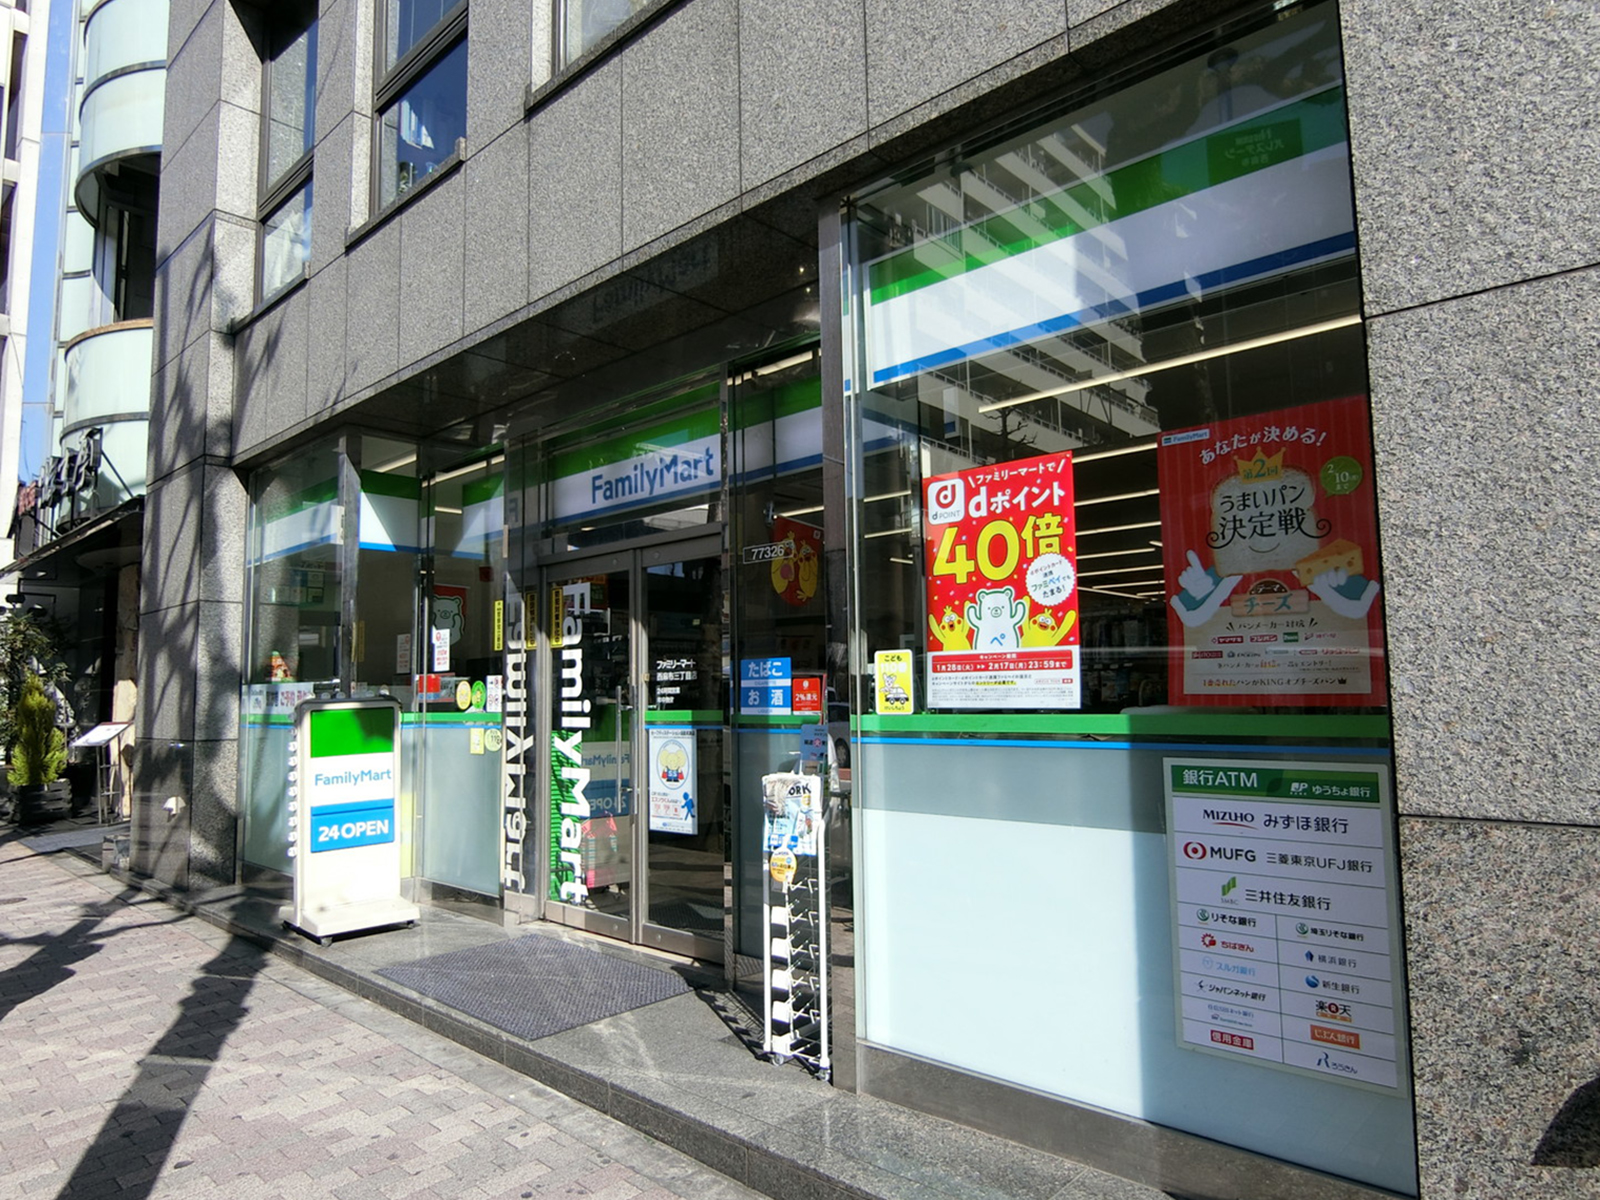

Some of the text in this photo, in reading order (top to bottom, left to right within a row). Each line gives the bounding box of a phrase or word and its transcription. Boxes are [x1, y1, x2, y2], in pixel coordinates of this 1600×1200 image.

[1172, 431, 1208, 443] FamilyMart
[591, 447, 714, 504] FamilyMart
[976, 462, 1056, 483] ファミリーマートで
[968, 481, 1066, 517] dポイント
[1220, 485, 1305, 513] うまいパン
[1216, 507, 1312, 542] 決定戦
[751, 543, 785, 561] 77326
[932, 512, 1064, 585] 40倍
[1257, 583, 1280, 592] テーマ
[1244, 593, 1293, 614] チーズ
[656, 658, 697, 670] ファミリーマート
[747, 660, 783, 678] たばこ
[554, 583, 592, 904] FamilyMart
[314, 769, 392, 786] FamilyMart
[1182, 769, 1258, 787] 銀行ATM
[1312, 785, 1370, 798] ゆうちょ銀行
[1202, 809, 1255, 822] MIZUHO
[1263, 814, 1349, 833] みずほ銀行
[1210, 846, 1257, 863] MUFG
[1266, 852, 1373, 873] 三菱東京UFJ銀行
[1245, 889, 1331, 910] 三井住友銀行
[1211, 914, 1257, 928] りそな銀行
[1310, 927, 1364, 942] 埼玉りそな銀行
[1215, 961, 1256, 977] スルガ銀行
[1317, 954, 1357, 968] 横浜銀行
[1208, 983, 1266, 1001] ジャパンネット銀行
[1322, 980, 1360, 995] 新生銀行
[1211, 1031, 1253, 1048] 信用金庫
[1314, 1027, 1356, 1044] じぶん銀行
